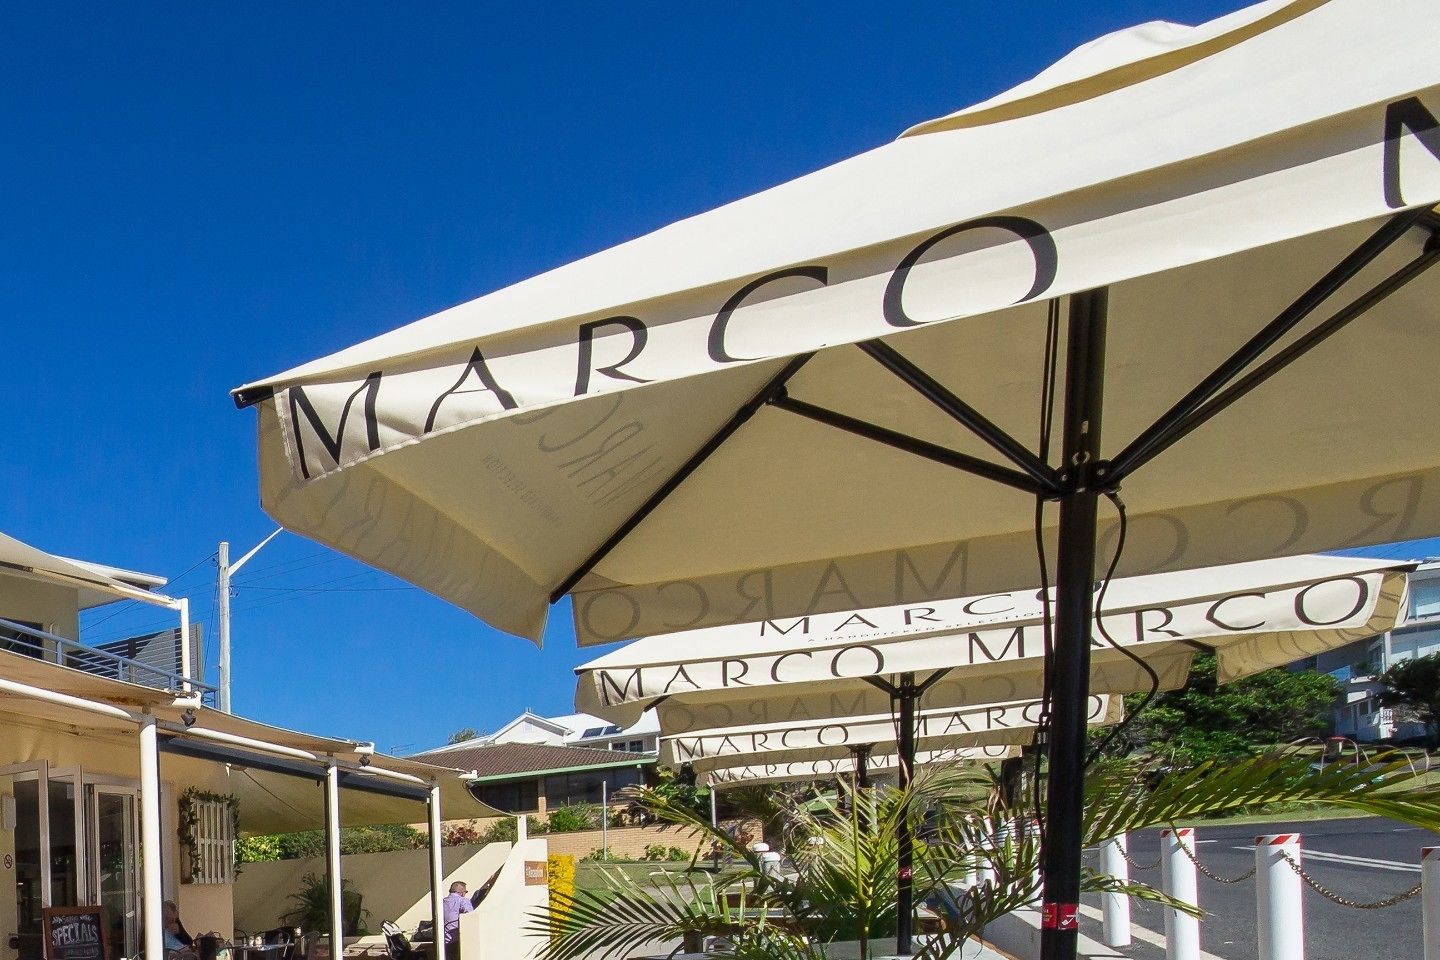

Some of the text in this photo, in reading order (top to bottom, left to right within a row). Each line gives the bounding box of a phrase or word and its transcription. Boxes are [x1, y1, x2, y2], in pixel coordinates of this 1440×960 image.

[288, 215, 1058, 480] MARCO
[760, 580, 1102, 637] MARC
[600, 644, 885, 706] MARCO
[968, 576, 1369, 664] MRCO
[676, 723, 850, 762] MARCO
[711, 758, 836, 783] MARCO
[52, 921, 100, 946] SPECIALS
